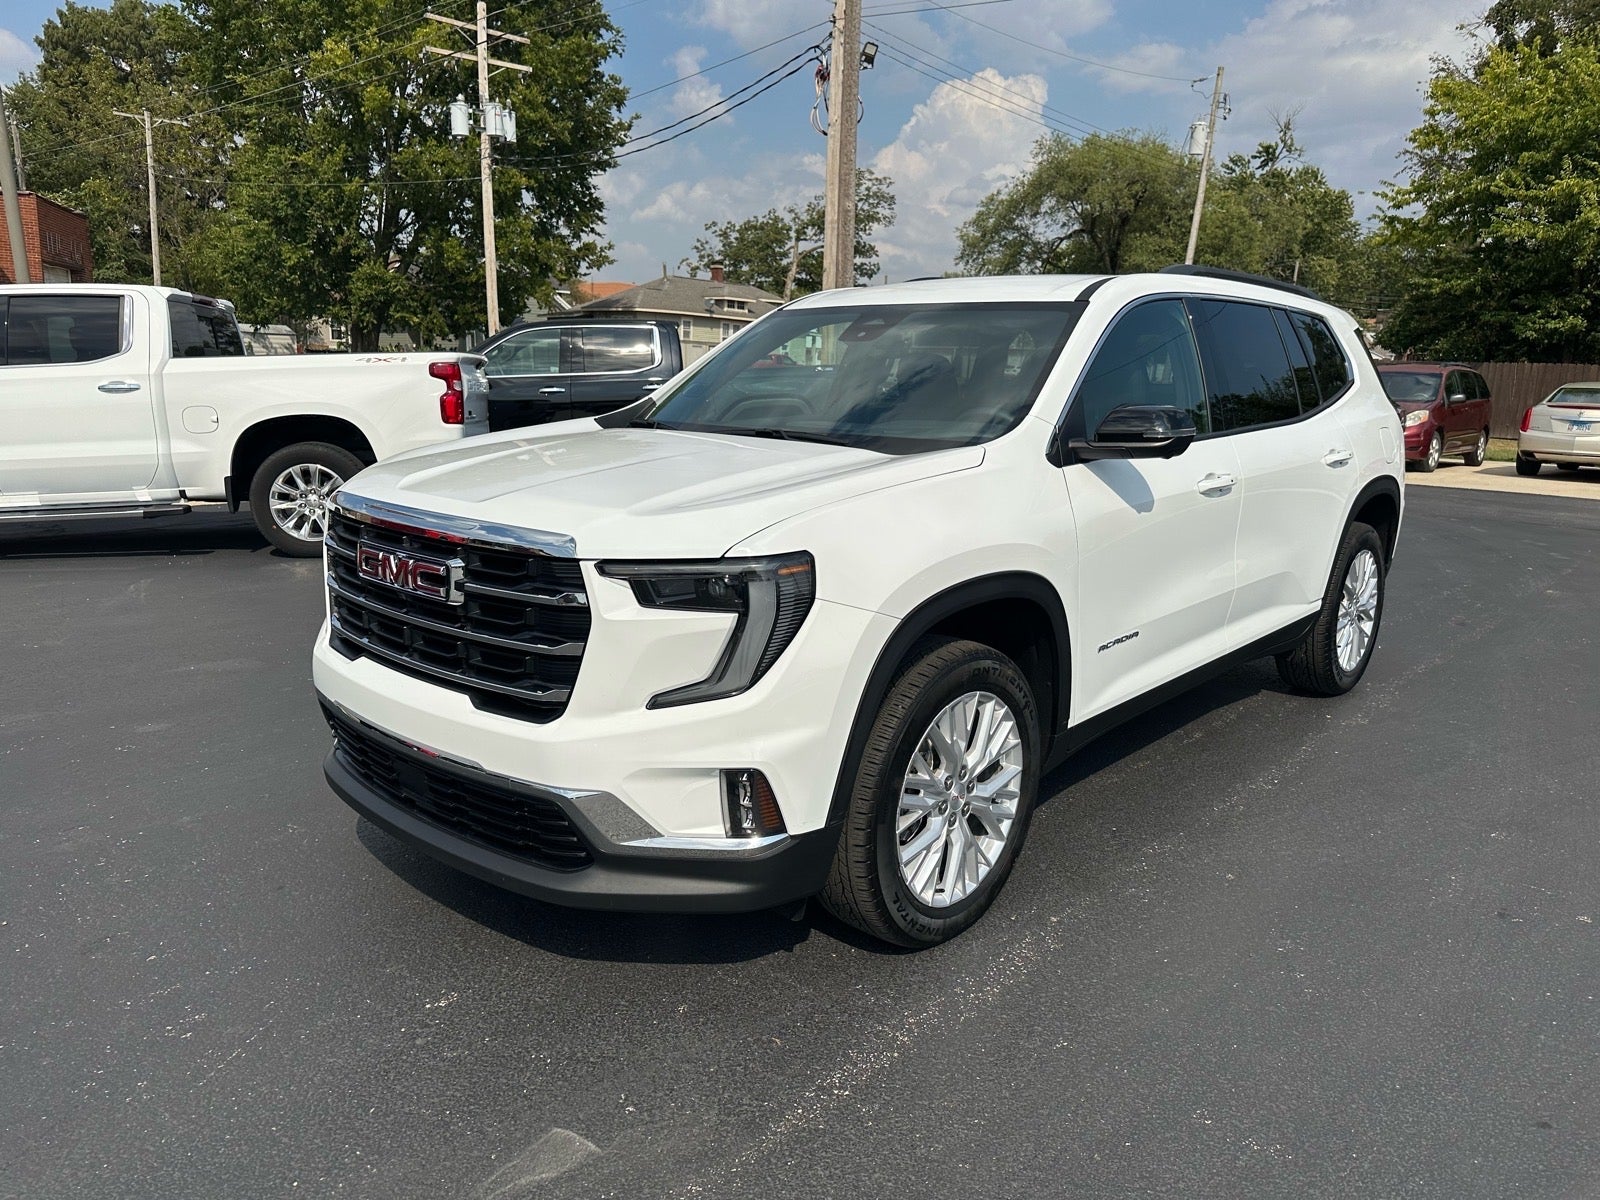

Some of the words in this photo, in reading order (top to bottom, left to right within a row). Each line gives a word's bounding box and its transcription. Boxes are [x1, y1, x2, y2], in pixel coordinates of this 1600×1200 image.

[359, 548, 447, 597] GMC
[1097, 631, 1140, 654] ACADIA
[971, 665, 1035, 721] ONTINENTAL
